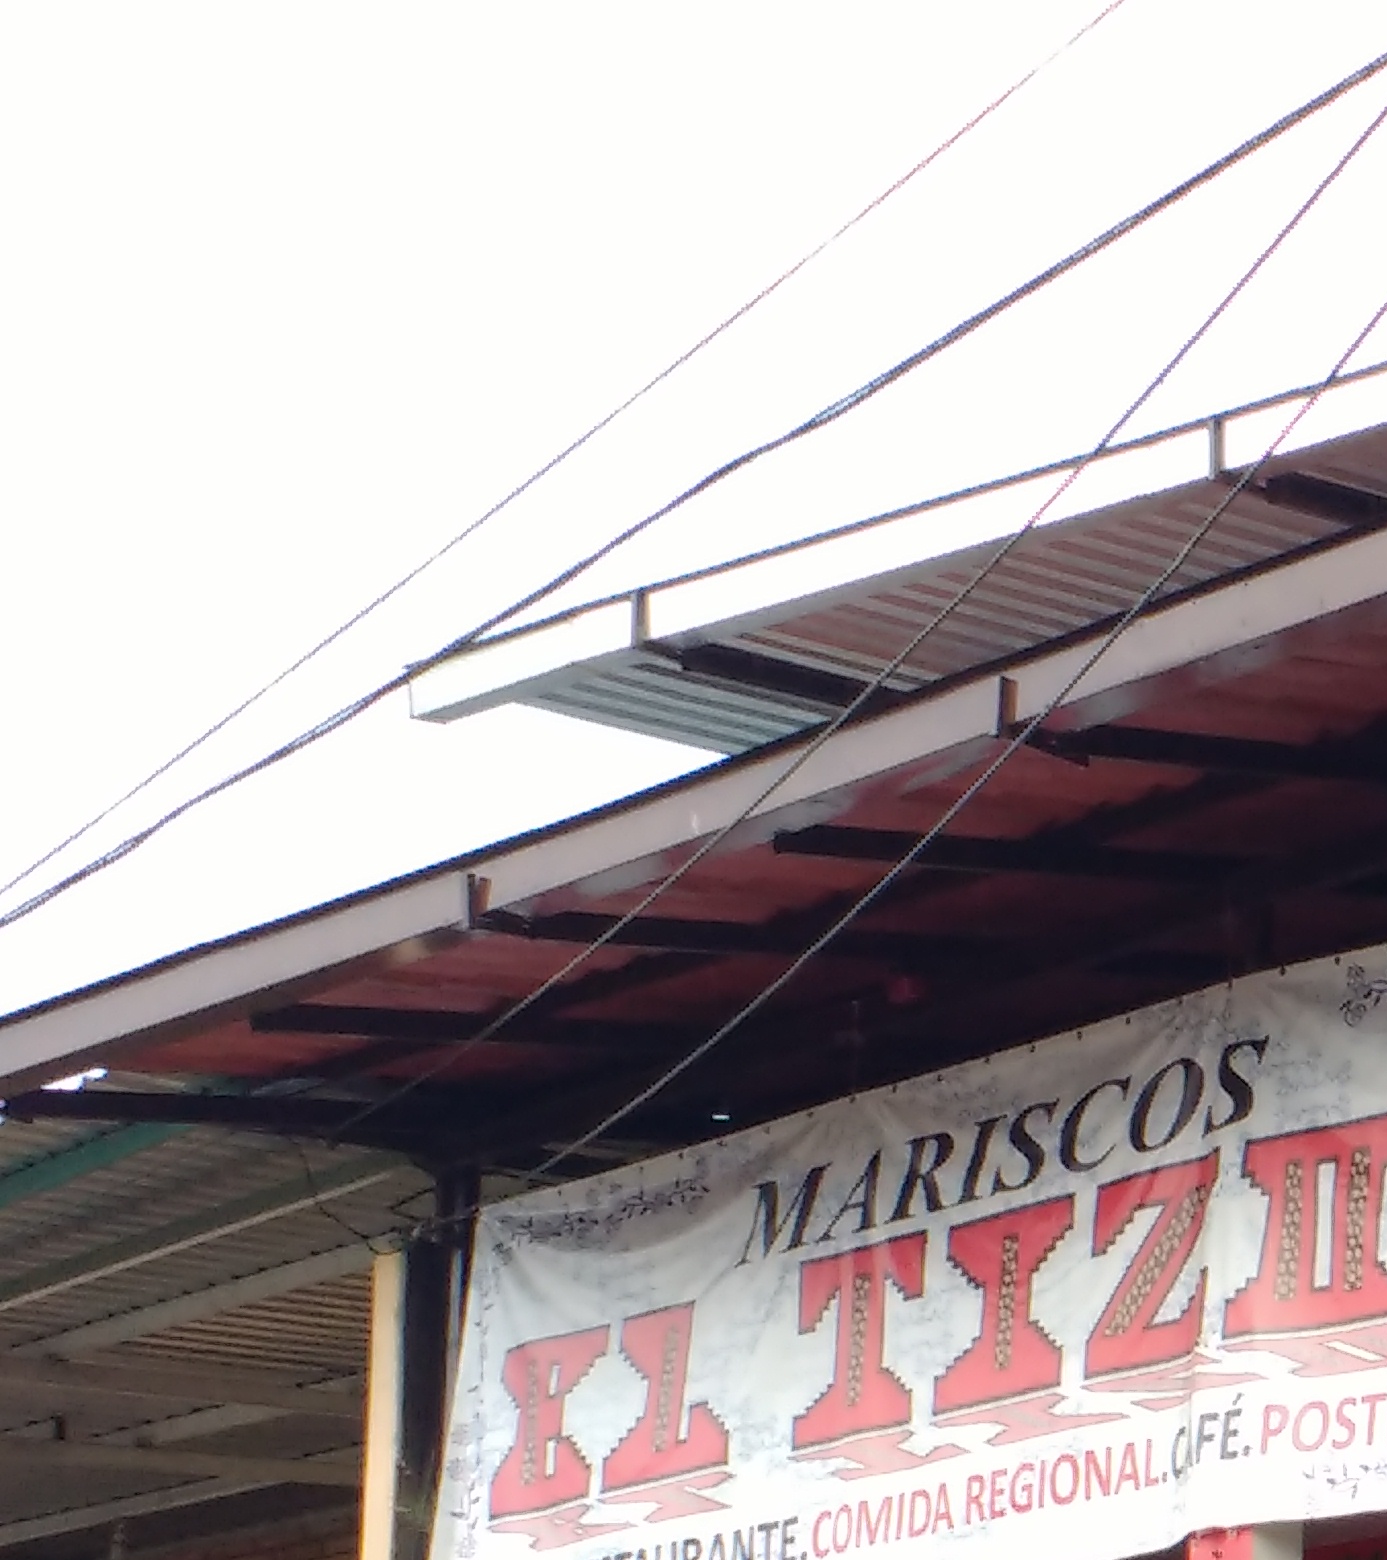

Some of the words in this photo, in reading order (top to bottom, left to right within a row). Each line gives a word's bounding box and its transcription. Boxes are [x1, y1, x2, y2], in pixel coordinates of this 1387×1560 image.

[737, 1036, 1270, 1268] MARISCOS
[488, 1300, 731, 1520] EL
[812, 1480, 953, 1560] COMIDA
